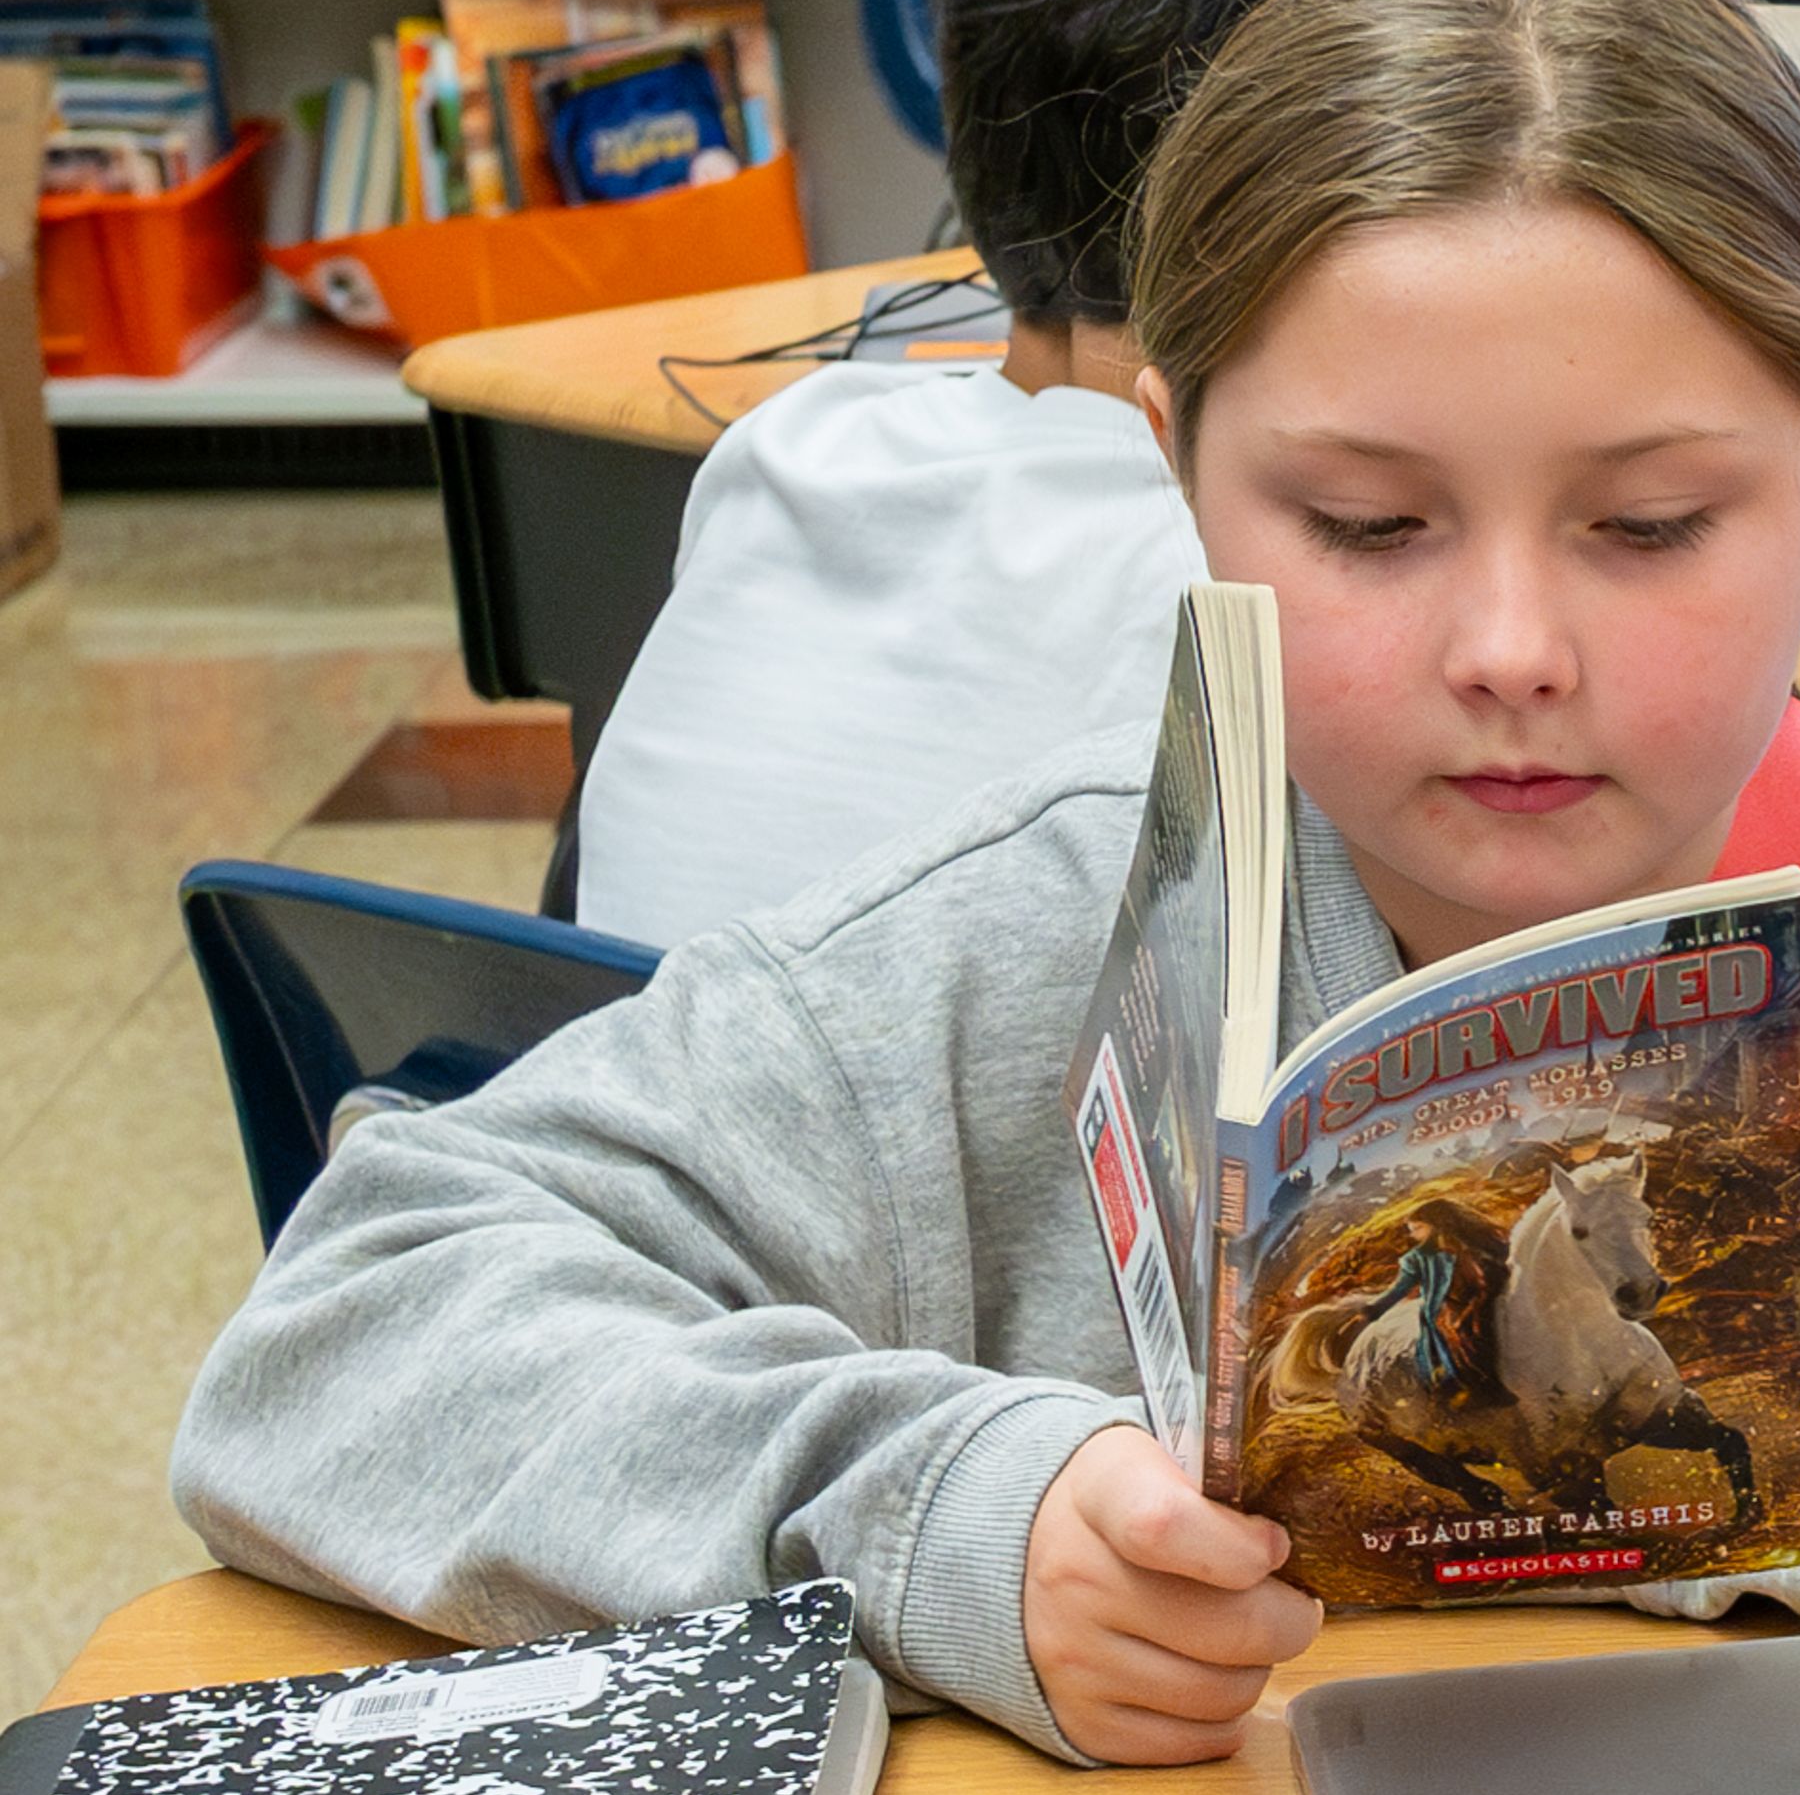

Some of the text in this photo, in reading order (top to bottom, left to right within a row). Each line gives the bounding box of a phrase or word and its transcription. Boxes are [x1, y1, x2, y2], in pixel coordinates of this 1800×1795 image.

[1277, 1096, 1310, 1174] I
[1319, 942, 1773, 1134] SURVIVED
[1413, 1080, 1511, 1121] GREAT
[1528, 1042, 1688, 1092] MOLASSES
[1547, 1080, 1614, 1107] 1919
[1362, 1502, 1715, 1552] by LAUREN TARSHIS
[1465, 1551, 1641, 1577] SCHOLASTIC
